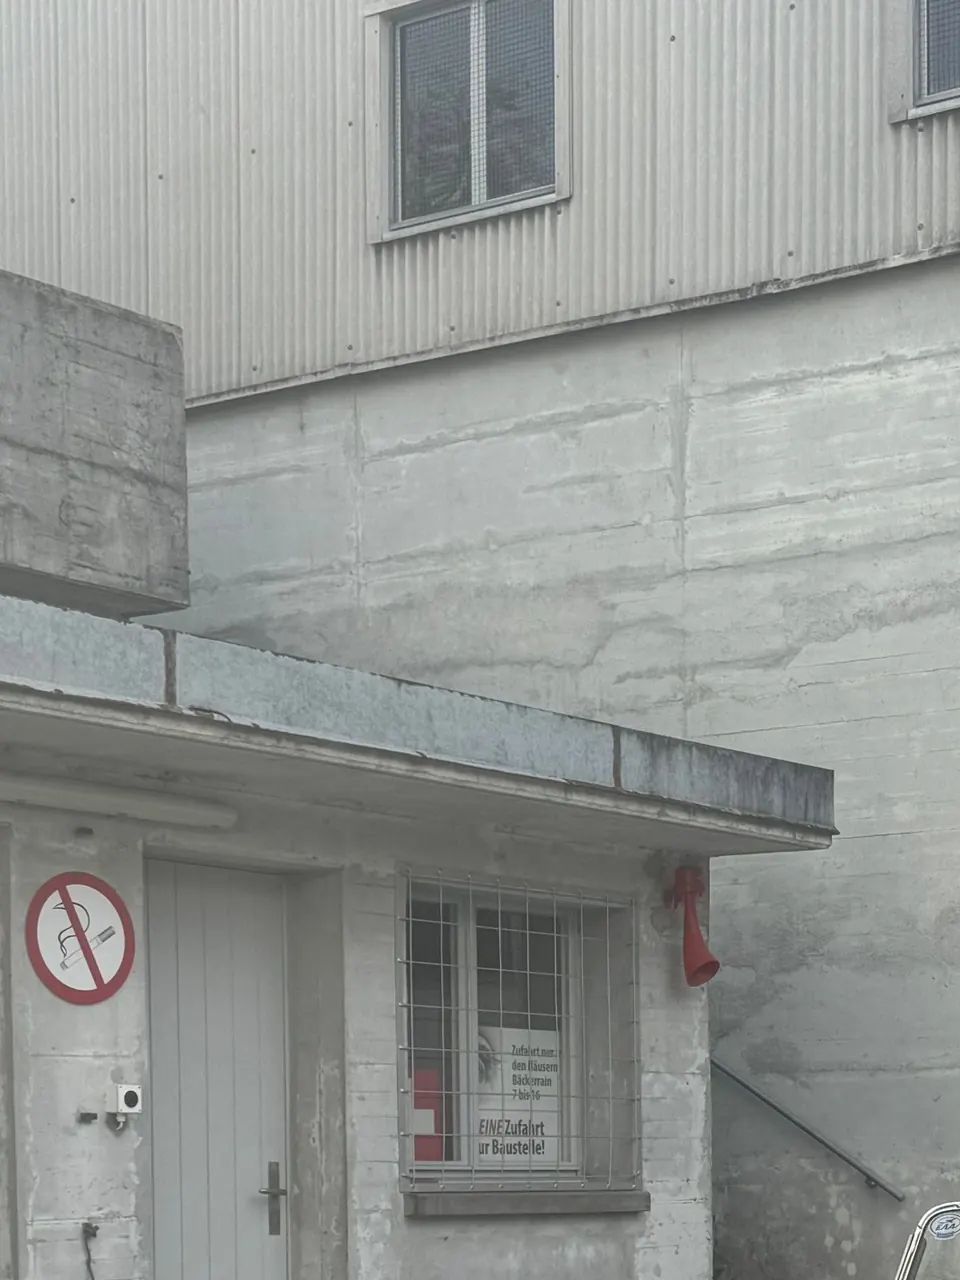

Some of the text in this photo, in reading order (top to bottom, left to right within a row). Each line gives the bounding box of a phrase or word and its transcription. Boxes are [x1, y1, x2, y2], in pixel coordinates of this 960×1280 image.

[511, 1044, 539, 1056] Zufahrt
[512, 1060, 526, 1071] den
[519, 1088, 530, 1101] bis
[531, 1090, 540, 1101] 16
[504, 1119, 545, 1136] Zufahrt
[492, 1139, 545, 1155] Baustelle!
